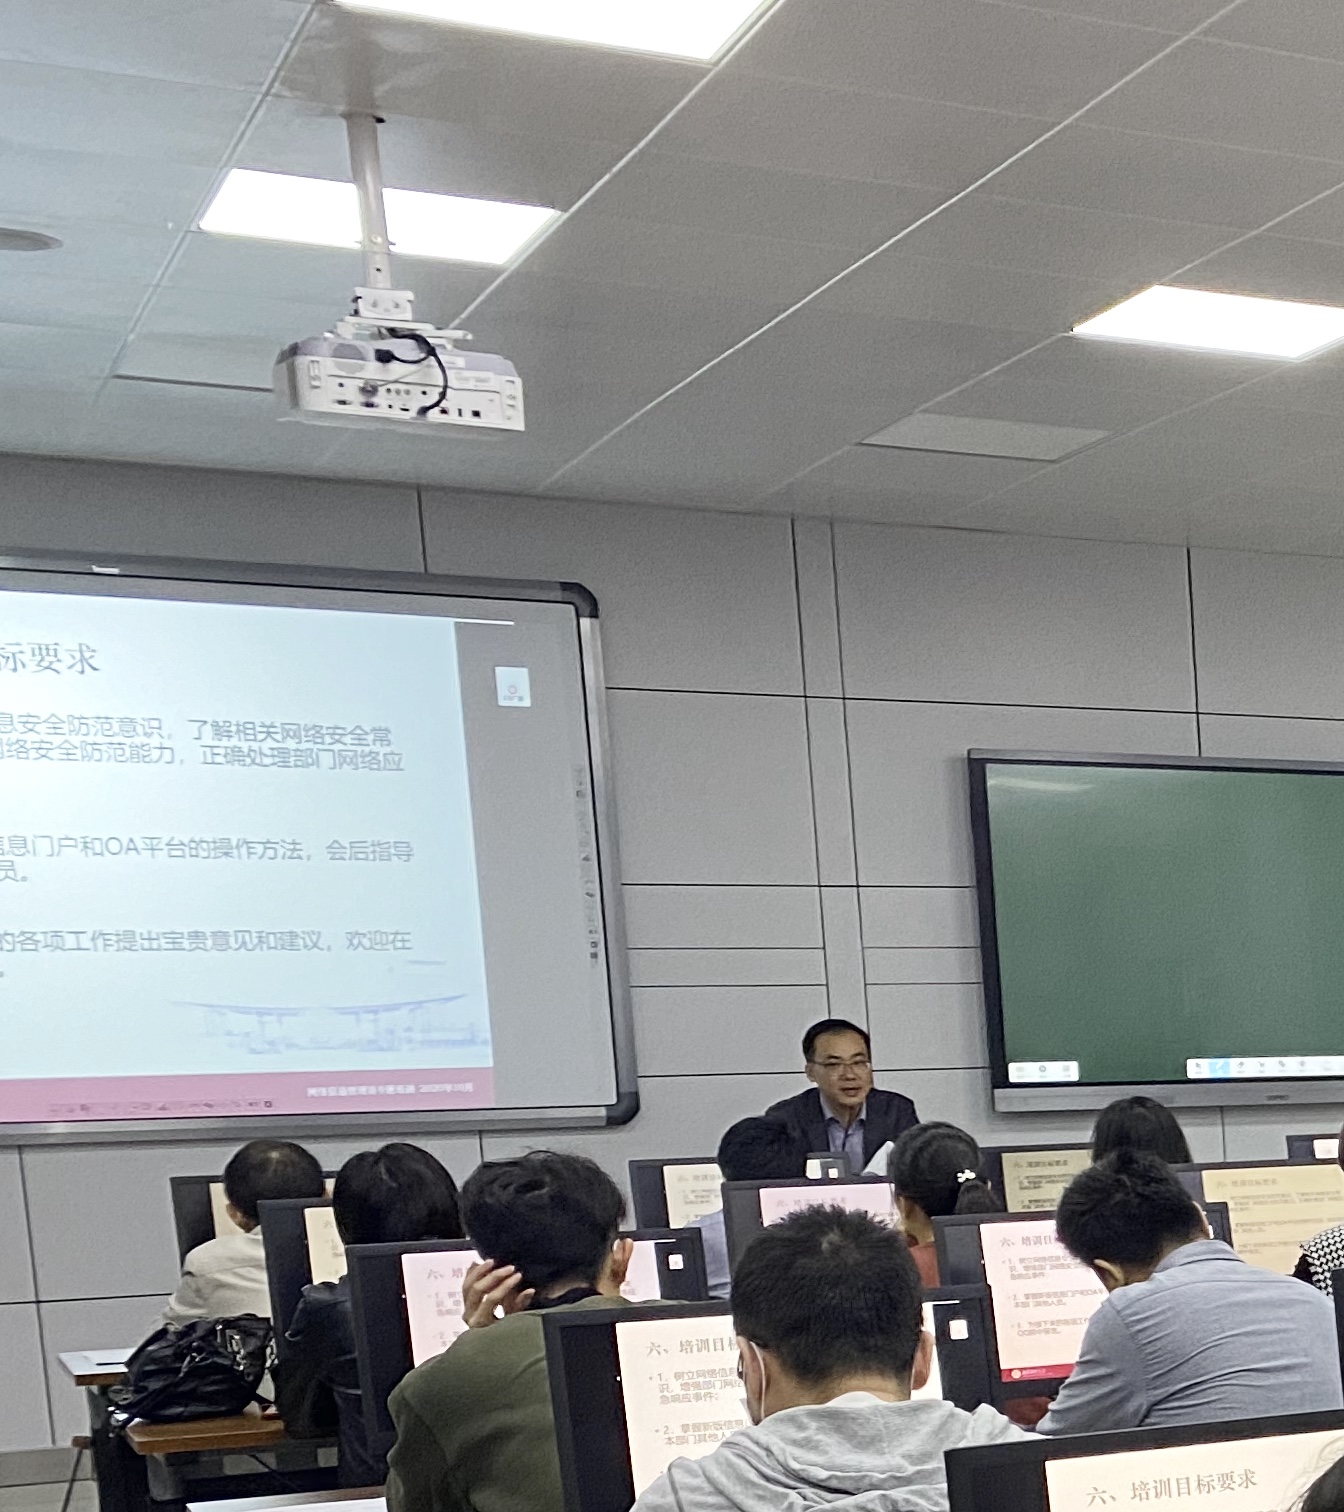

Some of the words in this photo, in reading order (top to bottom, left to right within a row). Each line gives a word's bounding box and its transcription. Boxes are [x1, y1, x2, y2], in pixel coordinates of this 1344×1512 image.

[0, 737, 404, 772] 络安全防范能力，正确处理部门网络应
[0, 834, 414, 863] 息门户和OA平台的操作方法，会后指导
[1086, 1468, 1258, 1507] 六、培训目标要求
